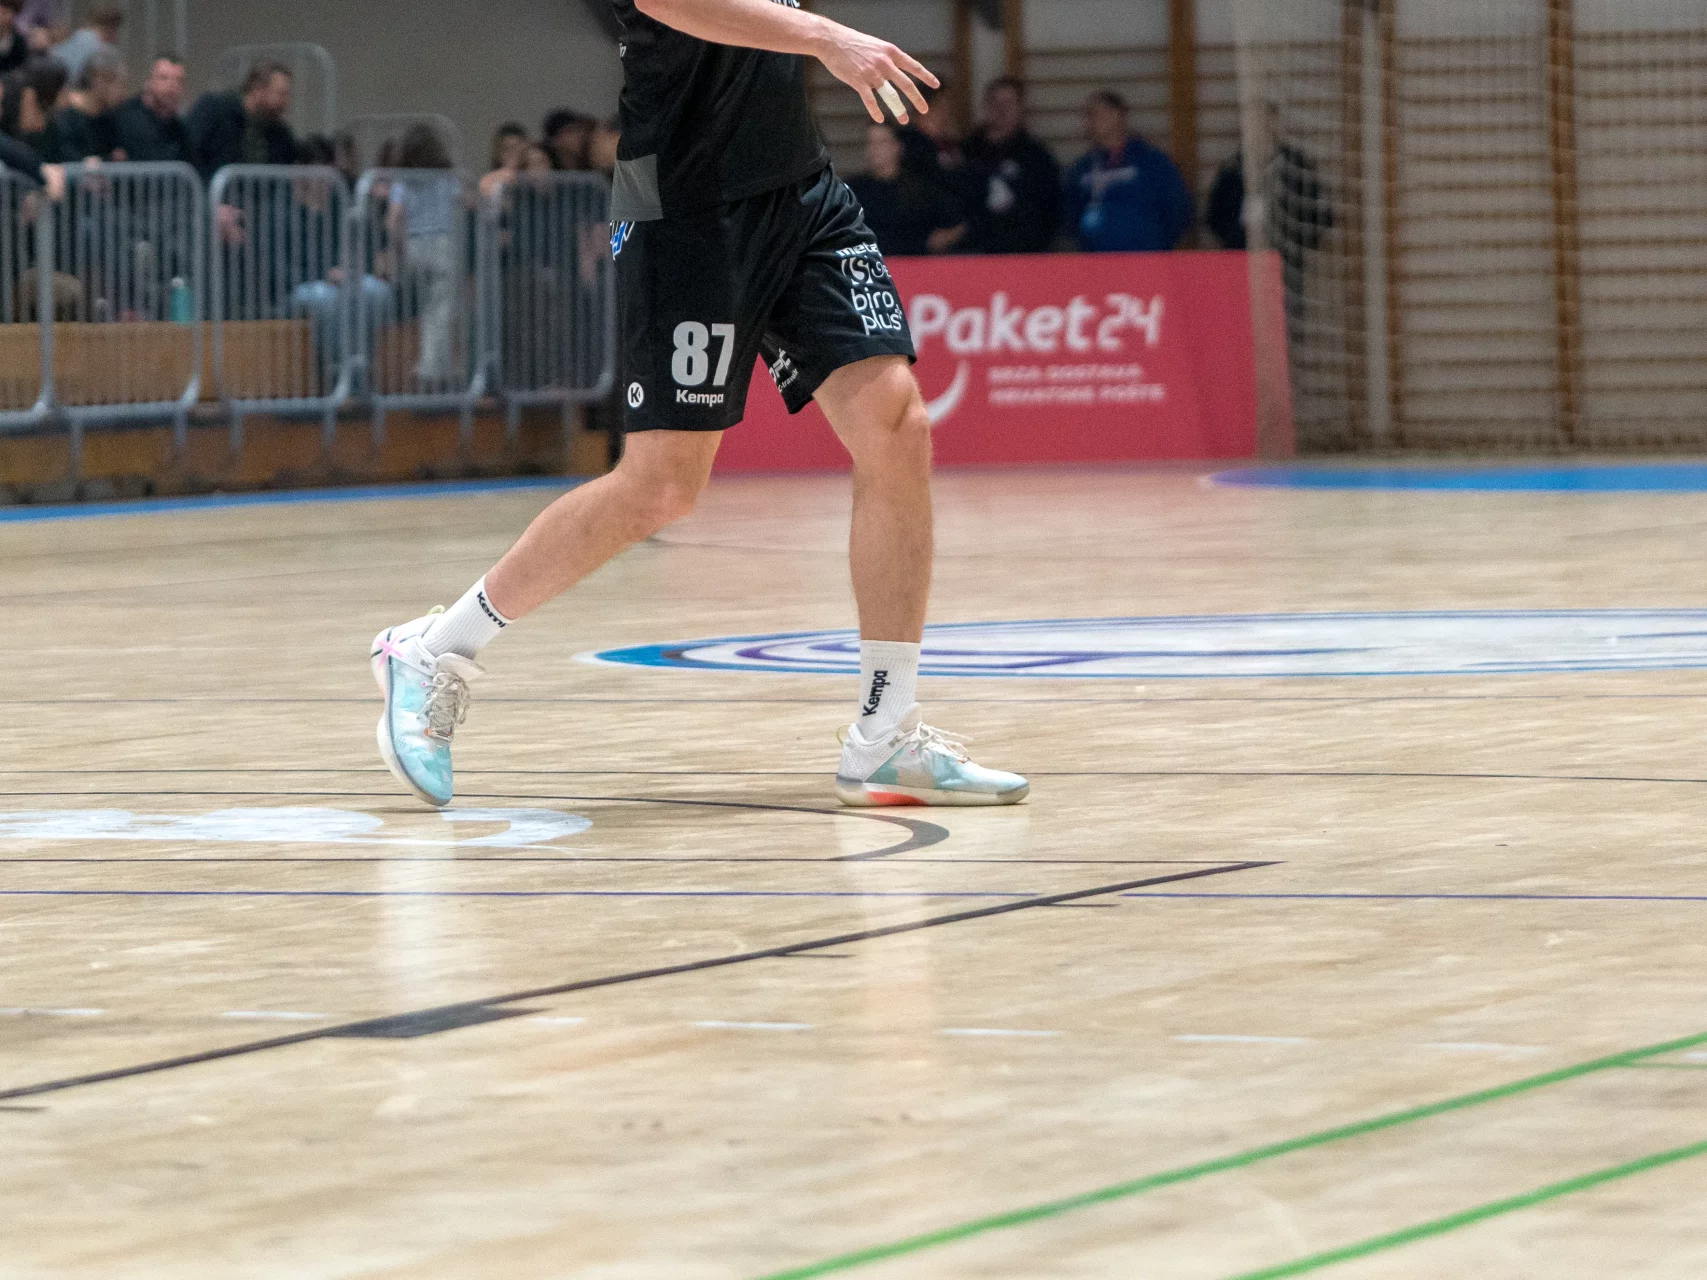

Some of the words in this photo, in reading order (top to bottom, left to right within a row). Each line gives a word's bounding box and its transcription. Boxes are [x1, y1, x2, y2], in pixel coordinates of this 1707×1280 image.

[851, 287, 894, 311] biro
[671, 321, 735, 386] 87
[676, 389, 724, 407] Kempa
[862, 670, 891, 717] Kempa
